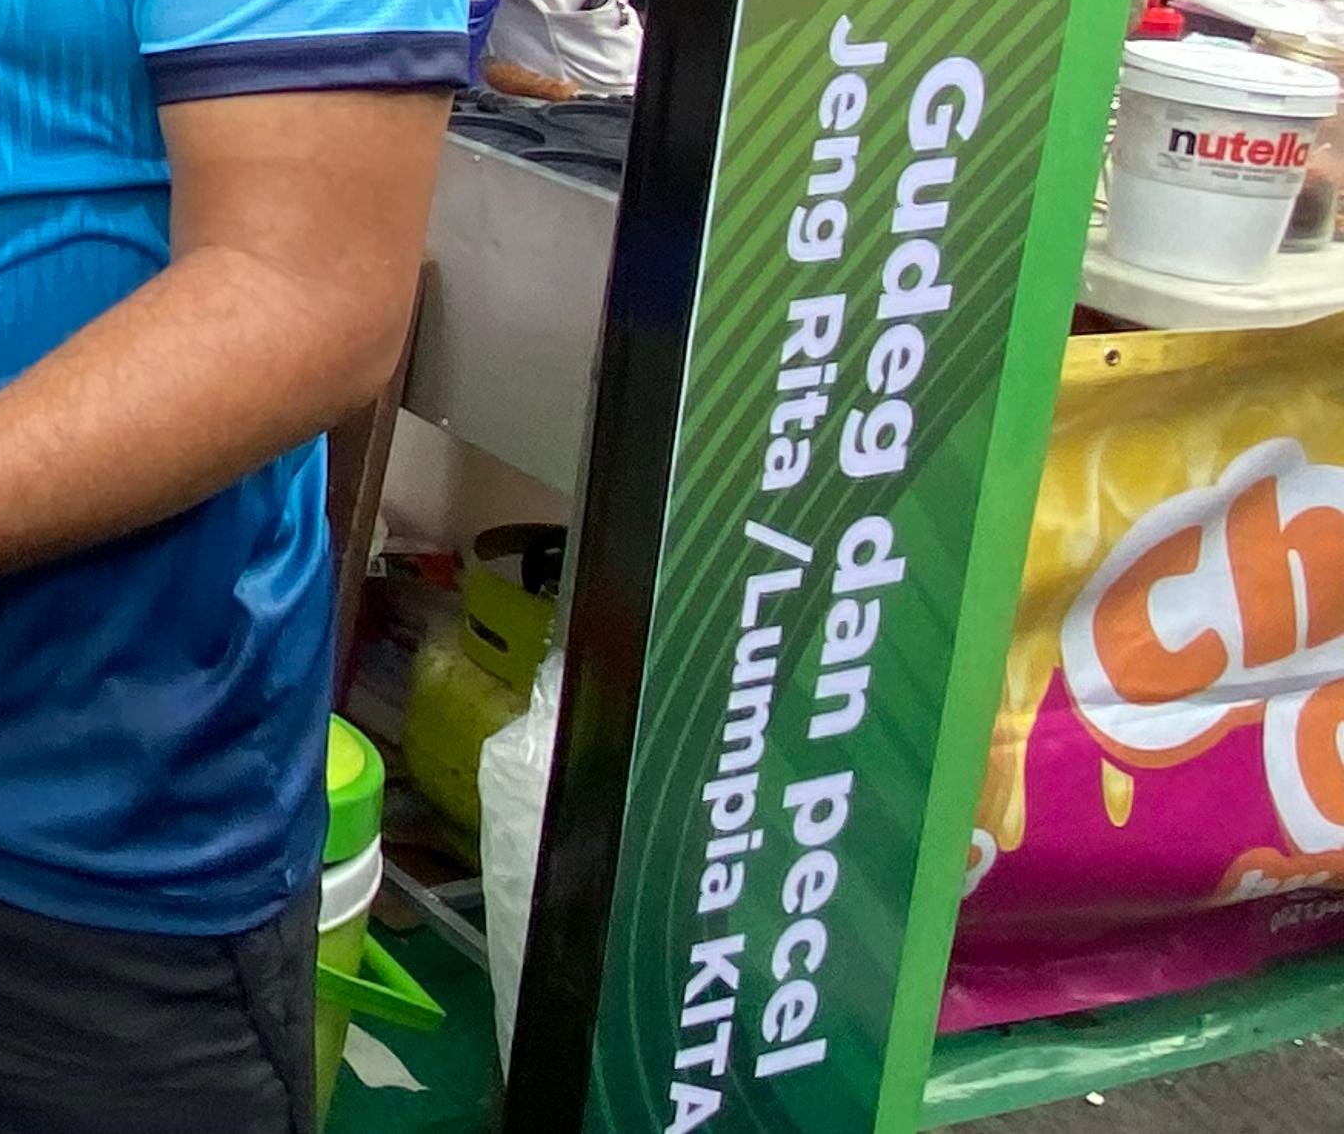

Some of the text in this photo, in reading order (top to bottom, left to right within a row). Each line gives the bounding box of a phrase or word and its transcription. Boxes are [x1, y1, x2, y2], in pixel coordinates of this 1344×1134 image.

[787, 14, 888, 262] Jeng
[1169, 128, 1311, 167] nutella
[762, 294, 847, 492] Rita
[755, 57, 984, 1078] Gudeg dan pecel
[664, 934, 745, 1134] KITA
